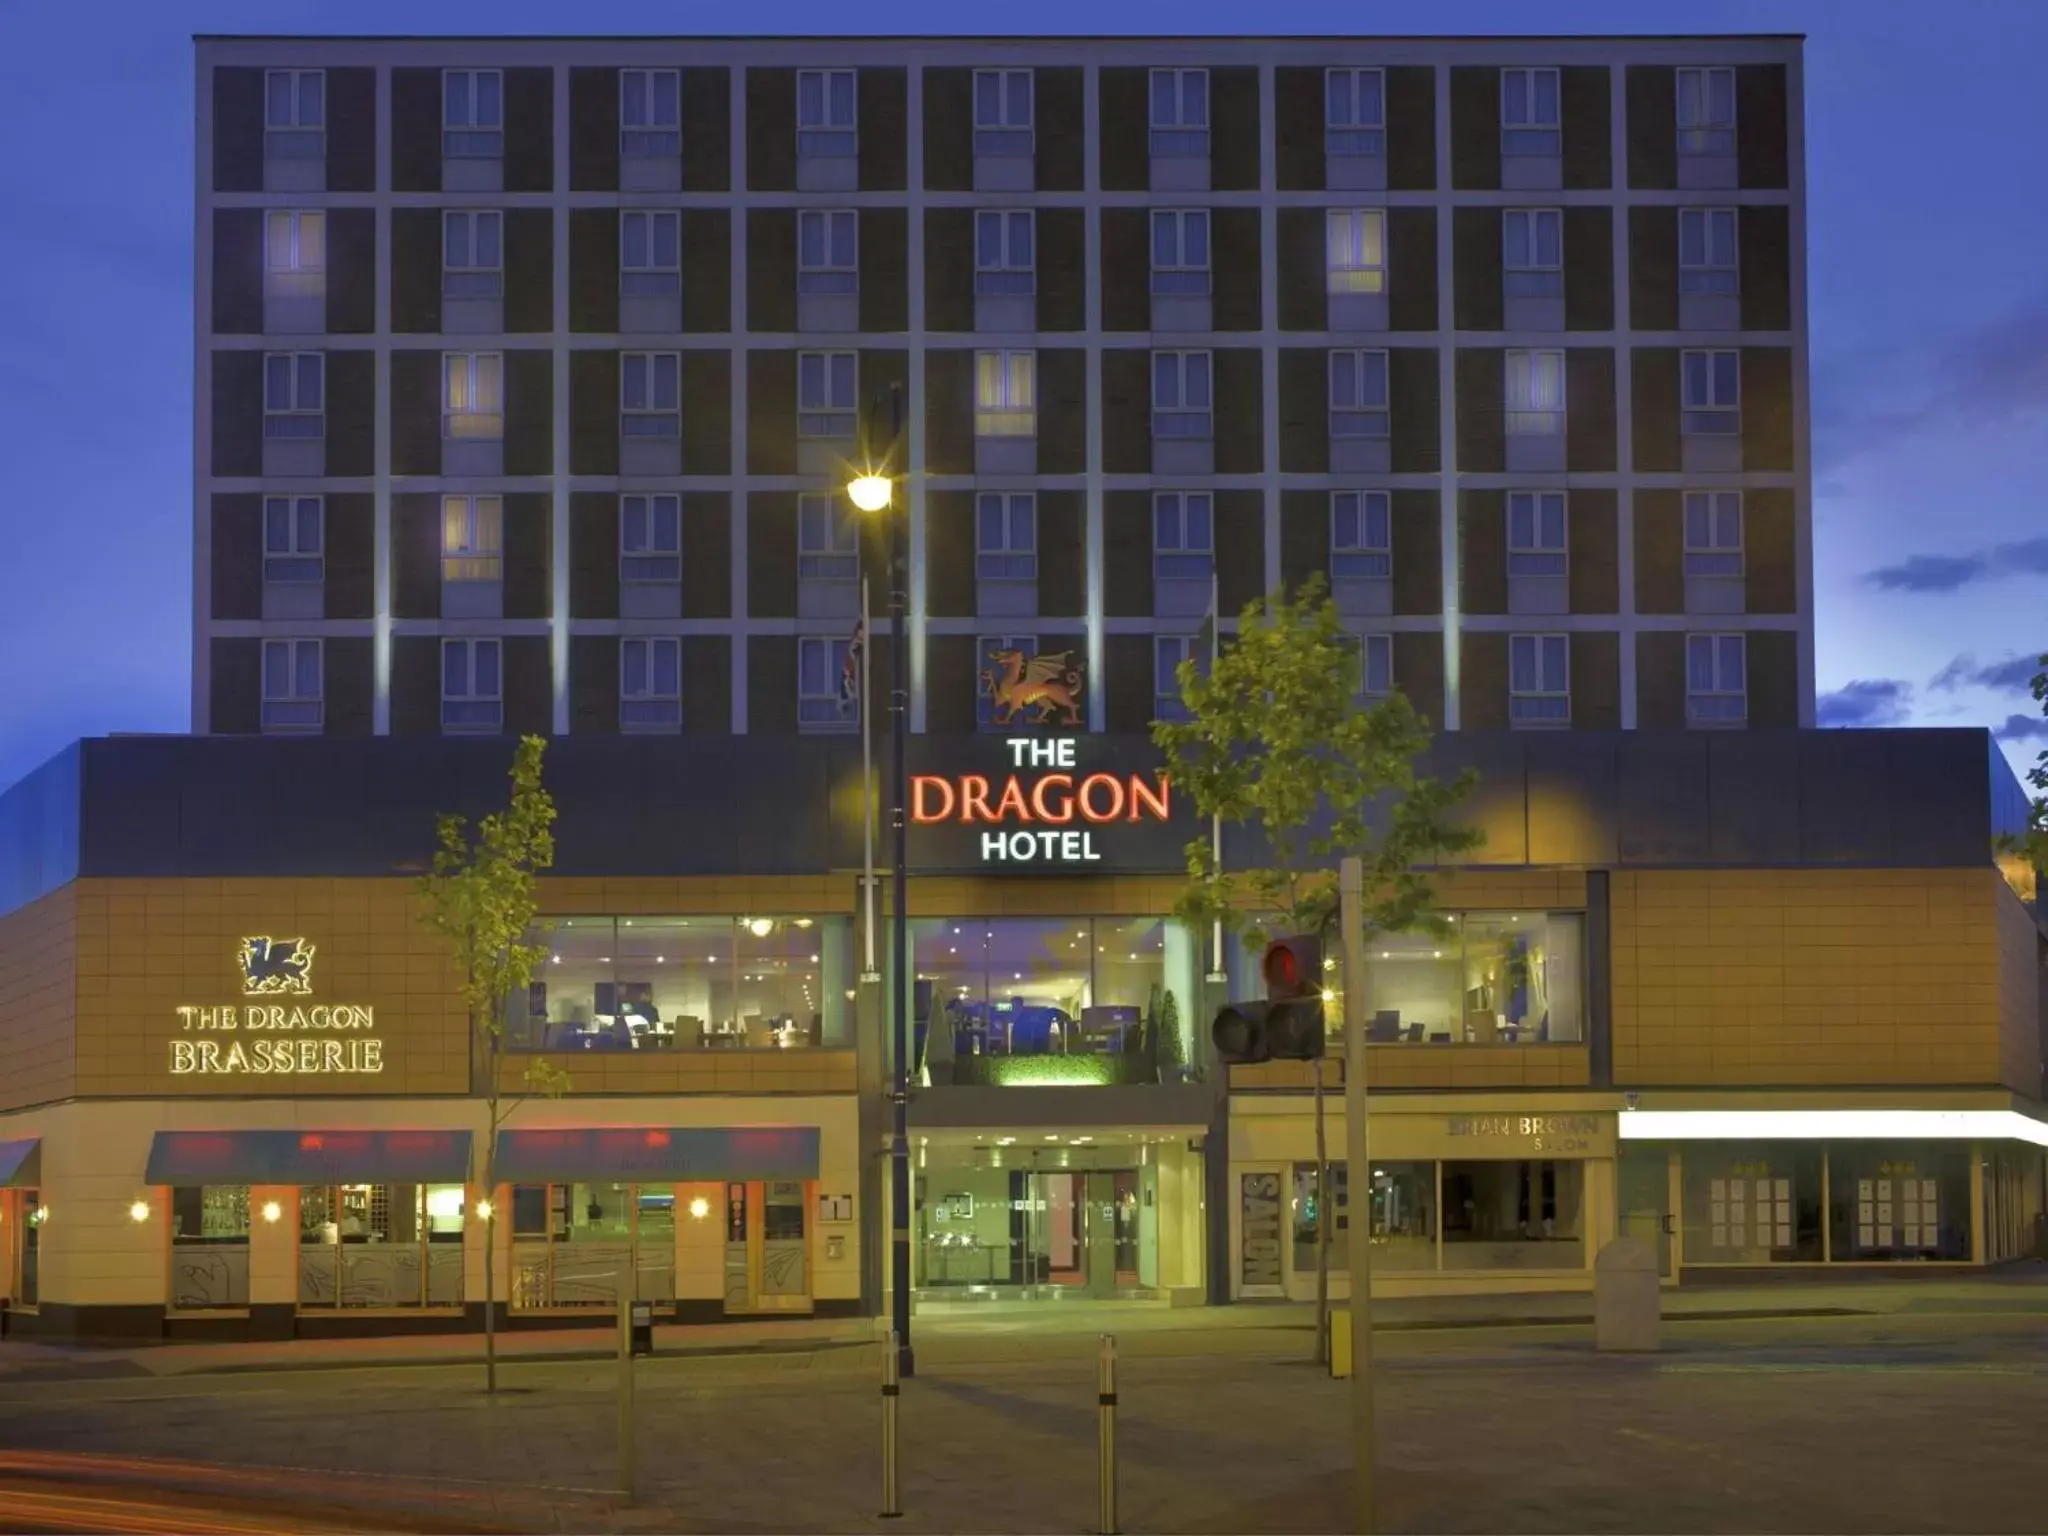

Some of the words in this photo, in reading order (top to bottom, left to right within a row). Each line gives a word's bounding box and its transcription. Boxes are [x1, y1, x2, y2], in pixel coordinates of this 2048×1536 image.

[1006, 738, 1076, 767] THE
[911, 774, 1170, 824] DRAGON
[981, 831, 1100, 860] HOTEL
[176, 1005, 238, 1029] THE
[245, 1005, 374, 1029] DRAGON
[168, 1039, 384, 1074] BRASSERIE
